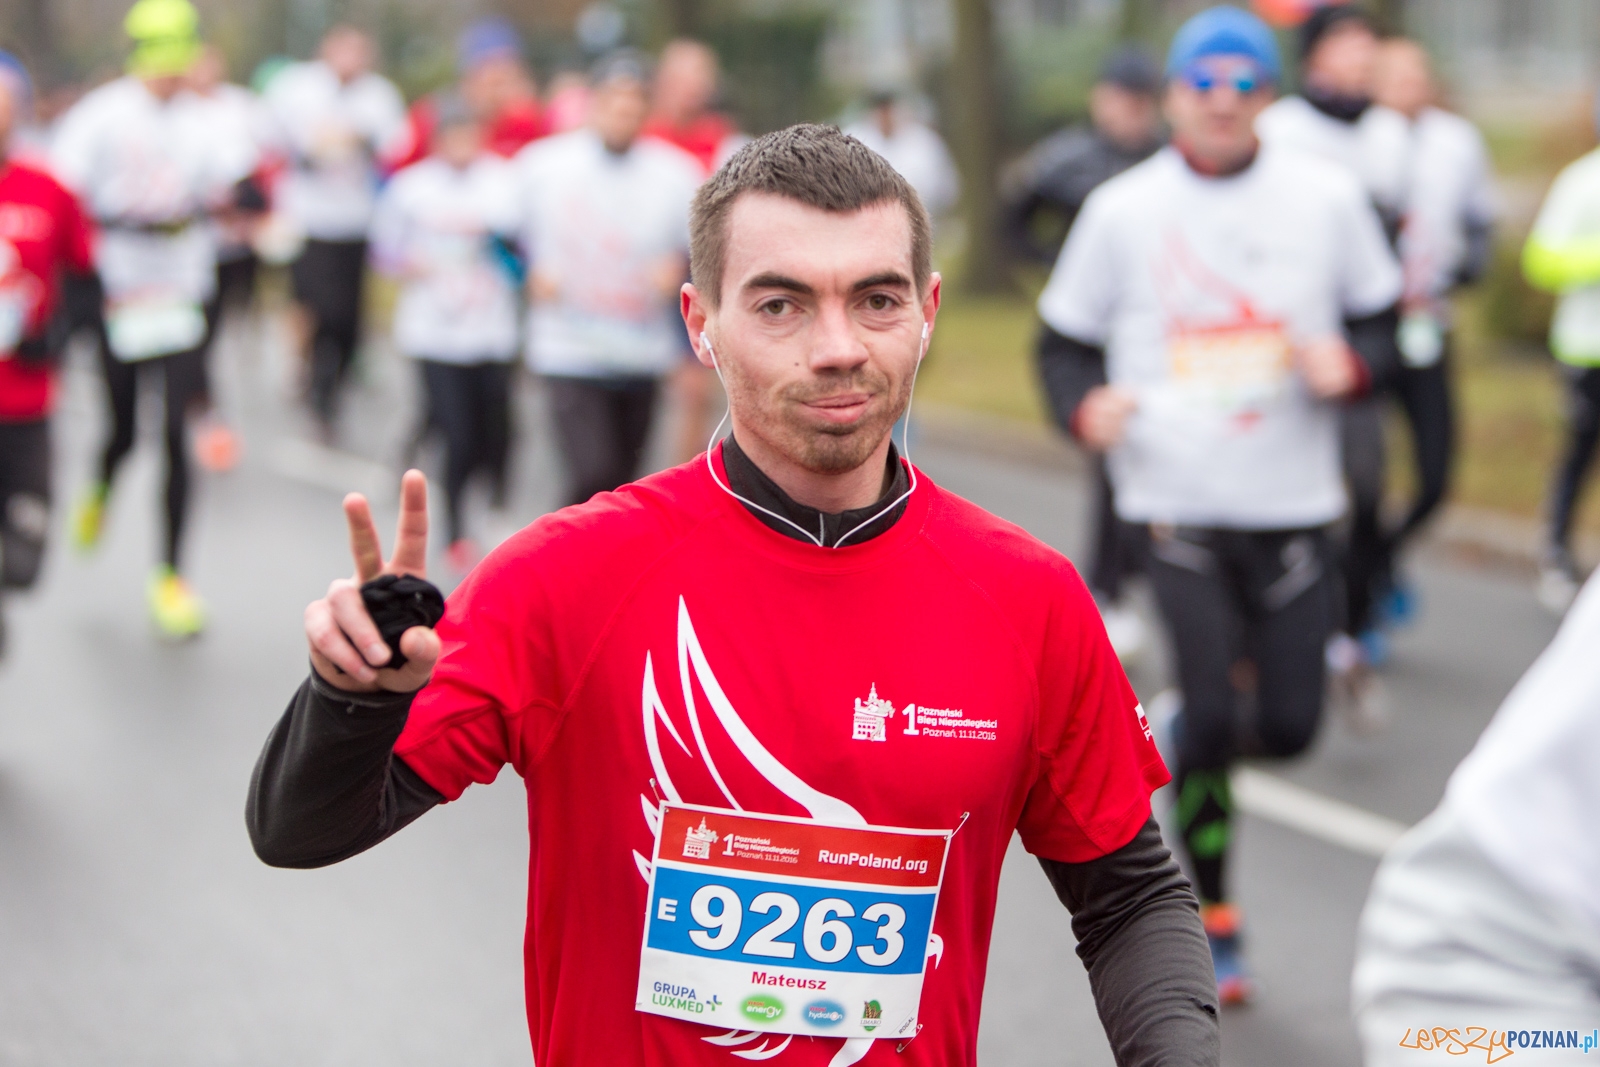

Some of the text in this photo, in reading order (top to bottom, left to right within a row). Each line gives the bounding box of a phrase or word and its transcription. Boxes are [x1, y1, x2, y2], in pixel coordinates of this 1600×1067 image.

[902, 703, 919, 735] 1
[917, 706, 963, 718] Poznański
[917, 715, 998, 729] Bieg Niepodległości
[958, 730, 996, 740] 11.11.2016
[722, 833, 735, 856] 1
[733, 841, 800, 855] Bieg Niepodległości
[734, 835, 771, 845] Poznański
[765, 853, 798, 864] 11.11.2016
[818, 849, 929, 873] RunPoland.org
[657, 884, 907, 967] E 9263
[751, 971, 827, 991] Mateusz
[653, 981, 697, 1000] GRUPA
[652, 993, 704, 1013] LUXMED
[746, 1005, 781, 1018] energy
